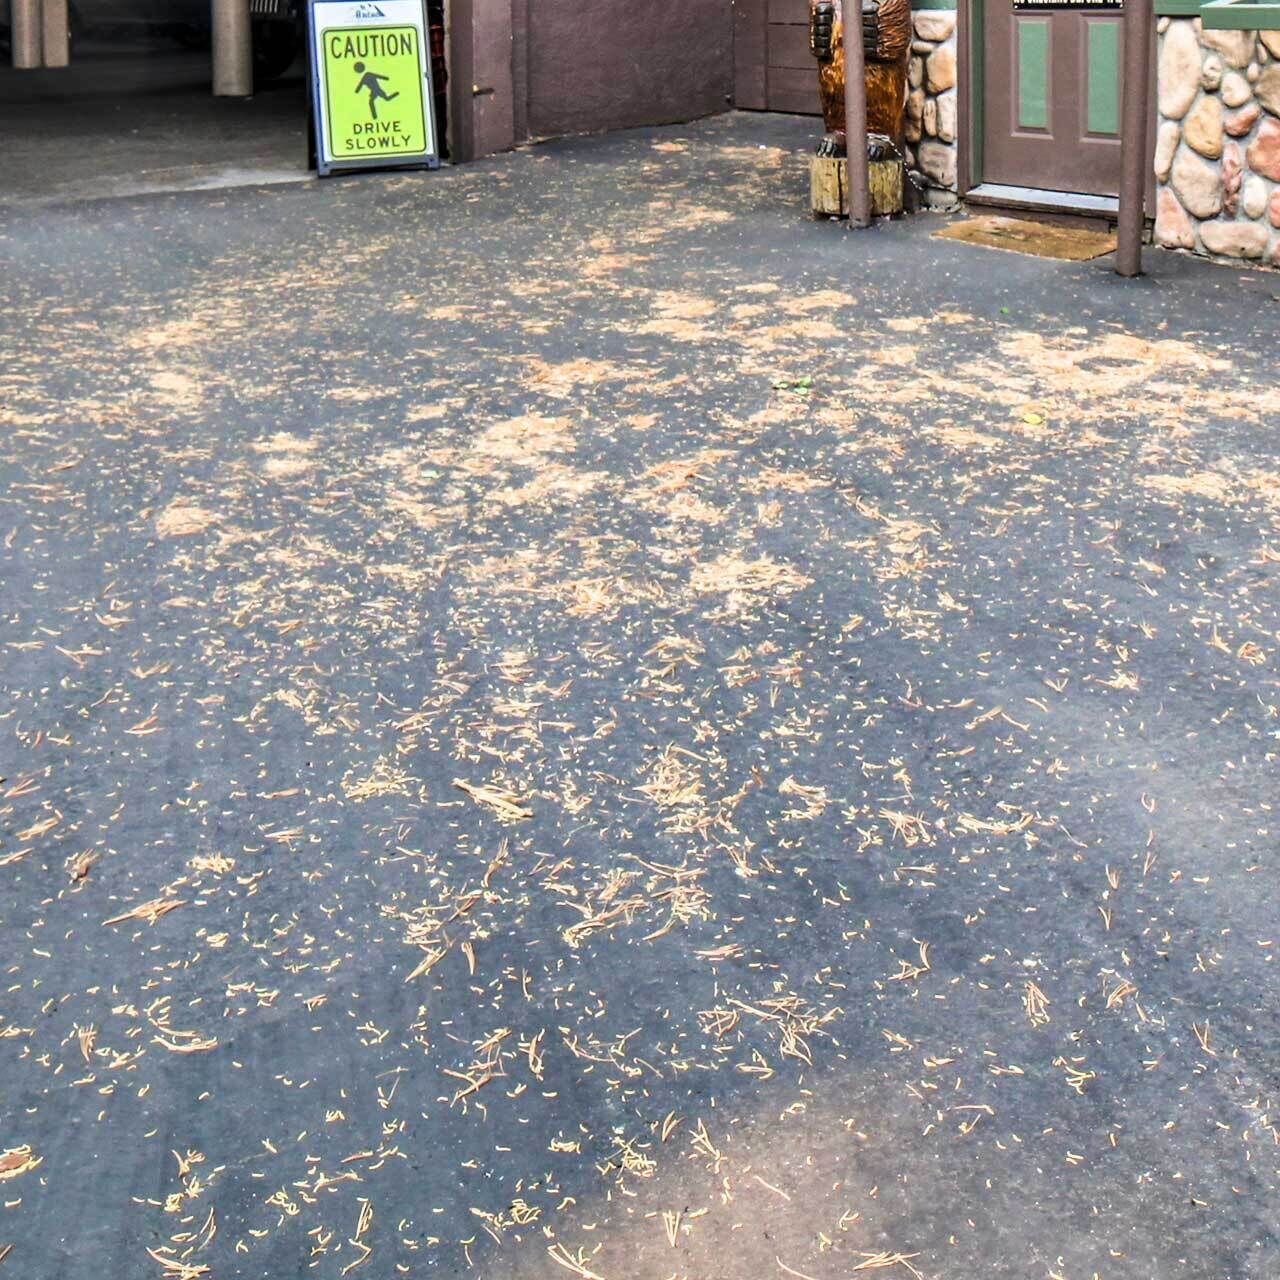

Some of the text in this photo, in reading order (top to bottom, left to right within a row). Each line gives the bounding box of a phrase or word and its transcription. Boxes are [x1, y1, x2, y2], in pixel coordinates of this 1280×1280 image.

[330, 33, 413, 59] CAUTION
[352, 120, 402, 135] DRIVE
[345, 135, 412, 151] SLOWLY
